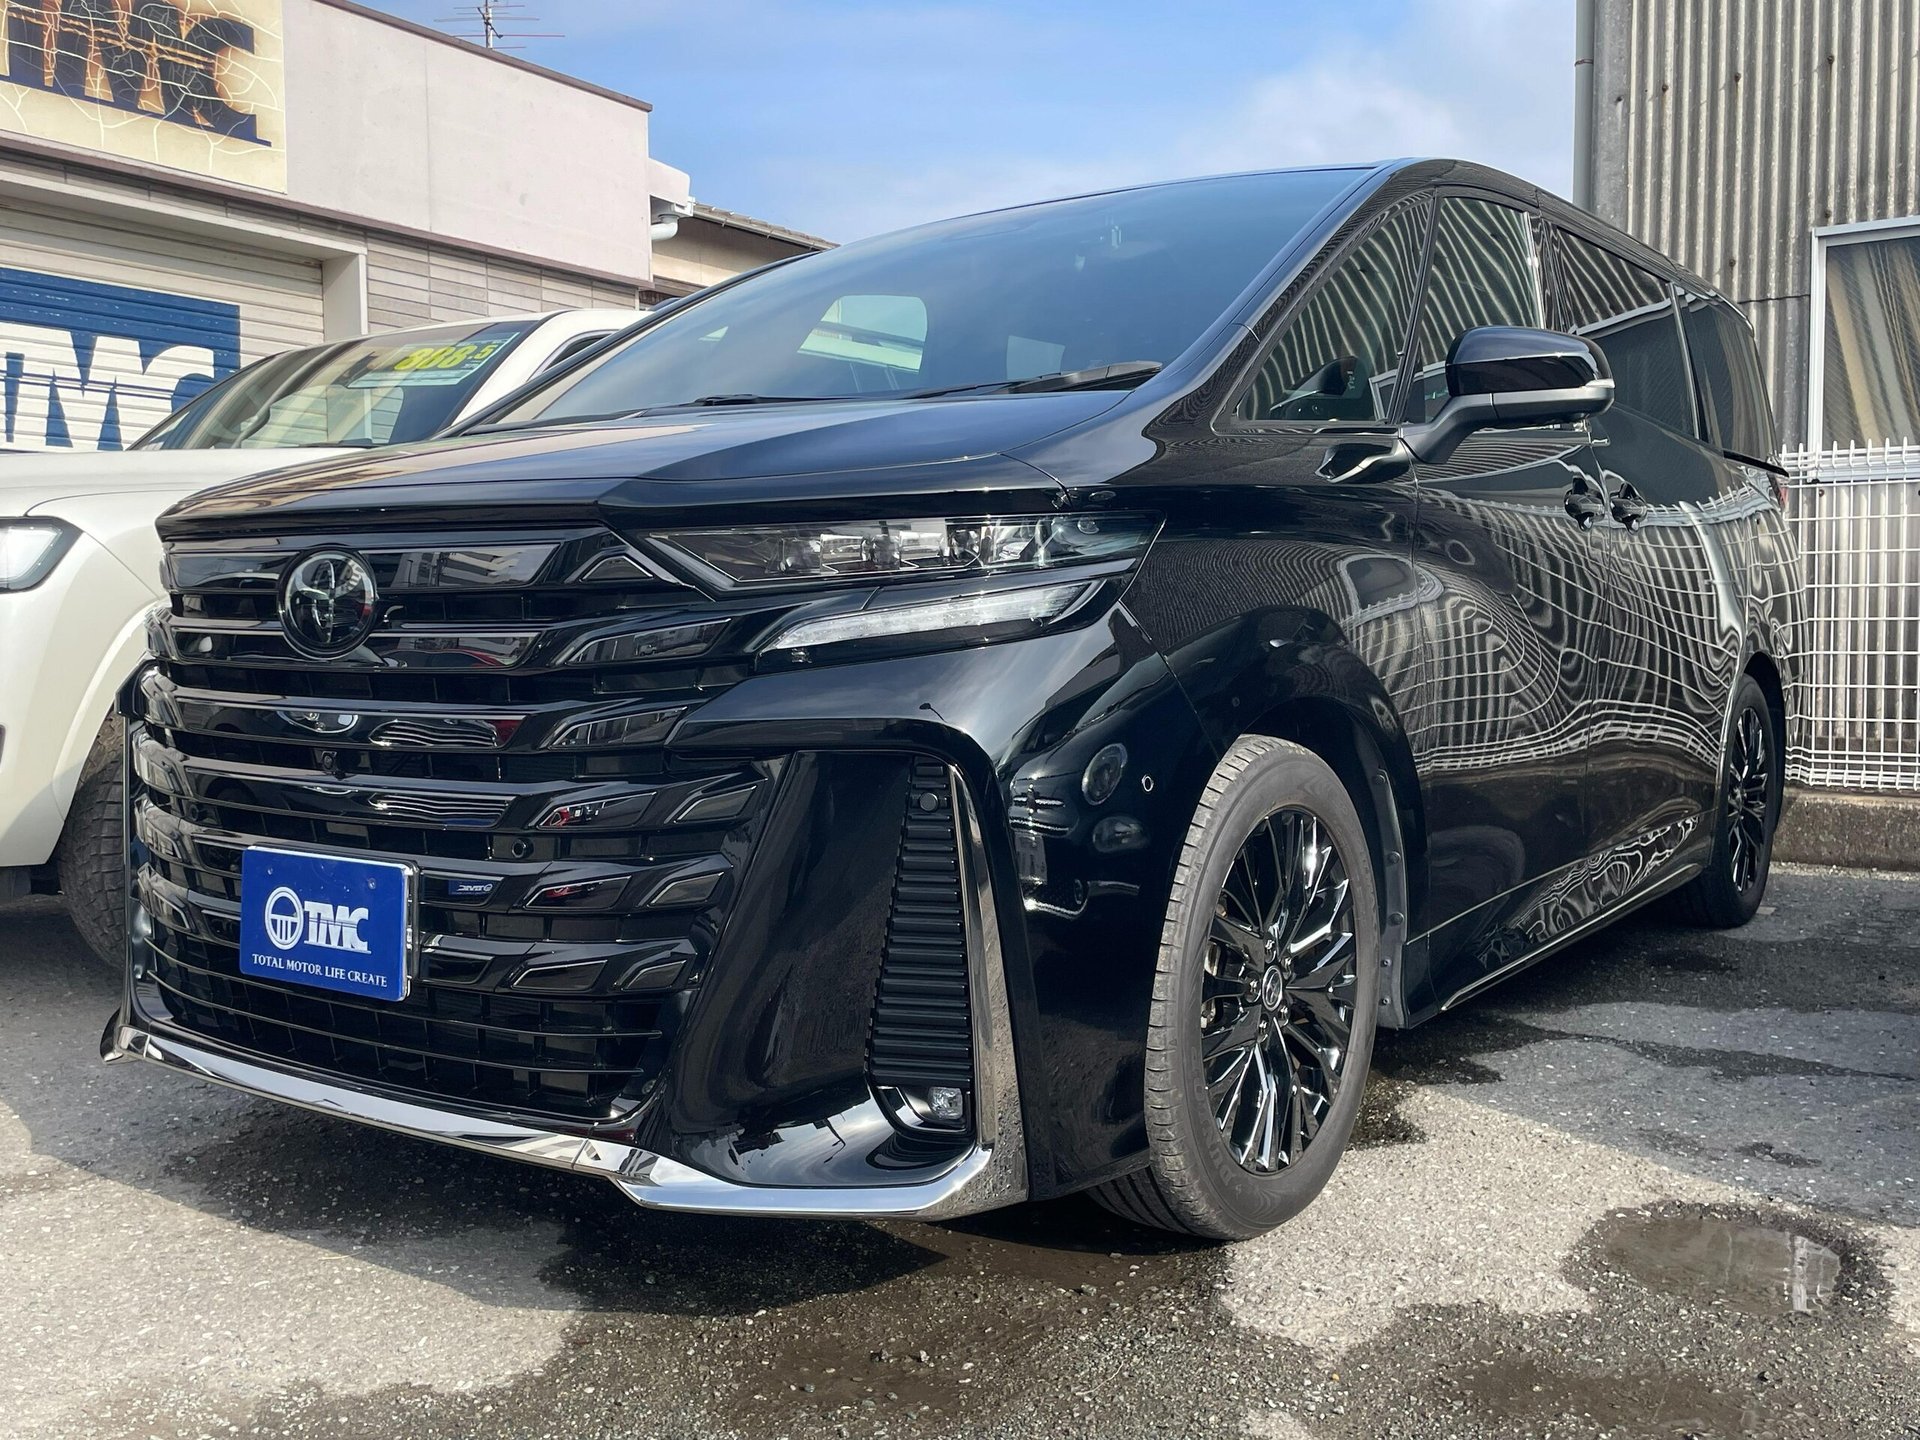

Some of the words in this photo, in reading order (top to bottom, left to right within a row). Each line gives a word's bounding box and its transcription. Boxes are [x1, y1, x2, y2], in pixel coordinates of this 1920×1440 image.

[304, 901, 371, 954] TMC
[252, 953, 285, 969] TOTAL
[286, 959, 322, 976] MOTOR
[325, 966, 346, 980] LIFE
[347, 970, 388, 988] CREATE
